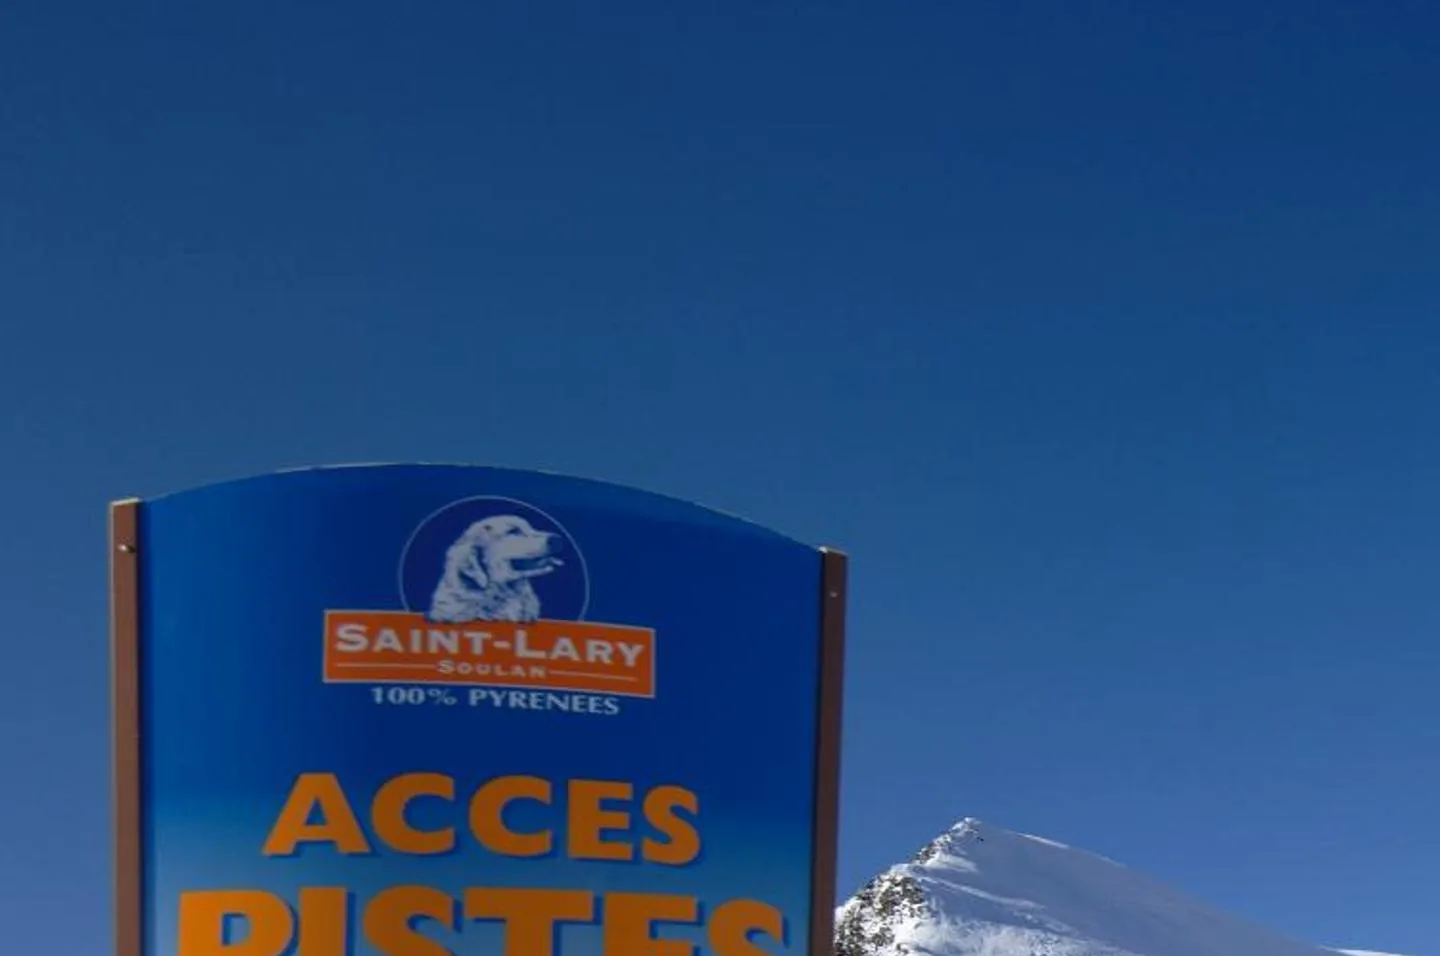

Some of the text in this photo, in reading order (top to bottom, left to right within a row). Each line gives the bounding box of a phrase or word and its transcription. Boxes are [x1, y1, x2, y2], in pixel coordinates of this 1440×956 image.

[335, 622, 645, 668] SAINT-LARY
[371, 685, 620, 715] 100% PYRENEES
[261, 772, 702, 866] ACCES
